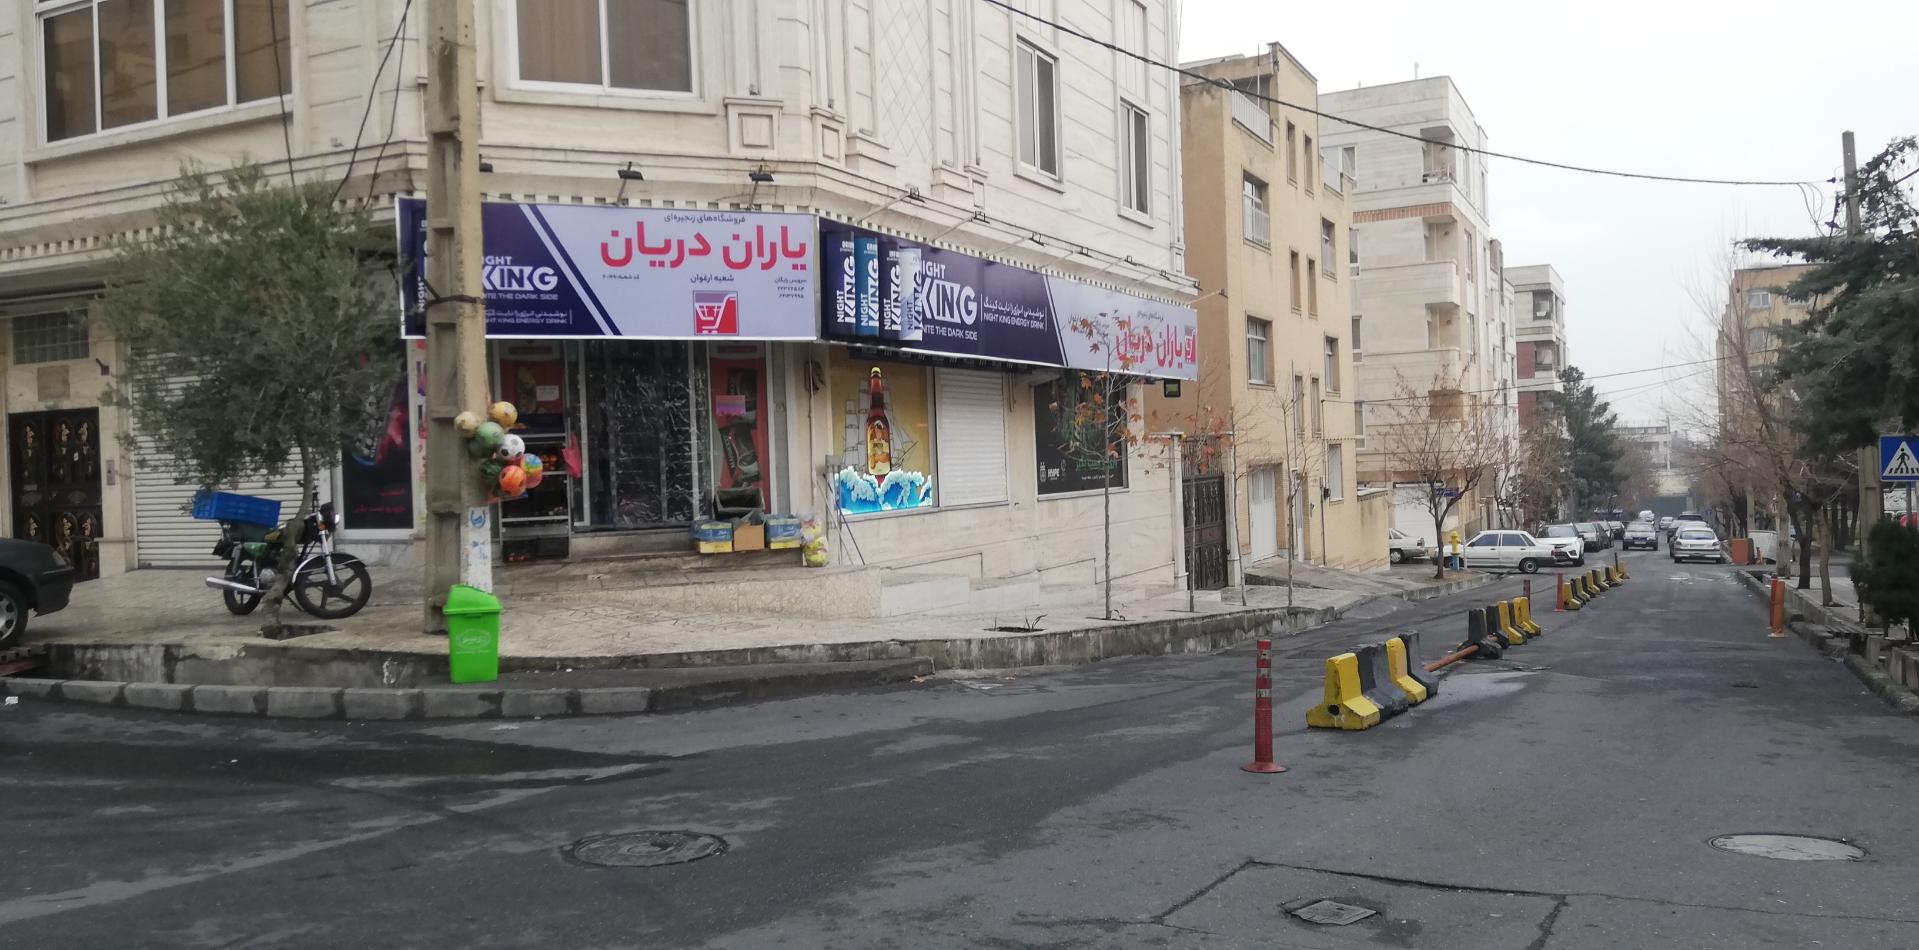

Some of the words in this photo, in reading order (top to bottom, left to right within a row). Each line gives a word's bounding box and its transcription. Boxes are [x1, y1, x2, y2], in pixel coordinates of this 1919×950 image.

[482, 256, 512, 264] IGHT
[600, 221, 712, 268] دریان
[722, 225, 807, 270] یاران
[690, 274, 713, 283] ارغوان
[922, 260, 946, 279] IGHT
[836, 290, 845, 323] NIGHT
[844, 256, 856, 324] KING
[868, 258, 879, 327] KING
[891, 264, 900, 331] KING
[936, 326, 947, 336] THE
[948, 327, 964, 338] DARK
[965, 330, 978, 340] SIDE
[984, 312, 998, 322] NIGHT
[999, 315, 1010, 325] KING
[1156, 324, 1182, 368] یاران
